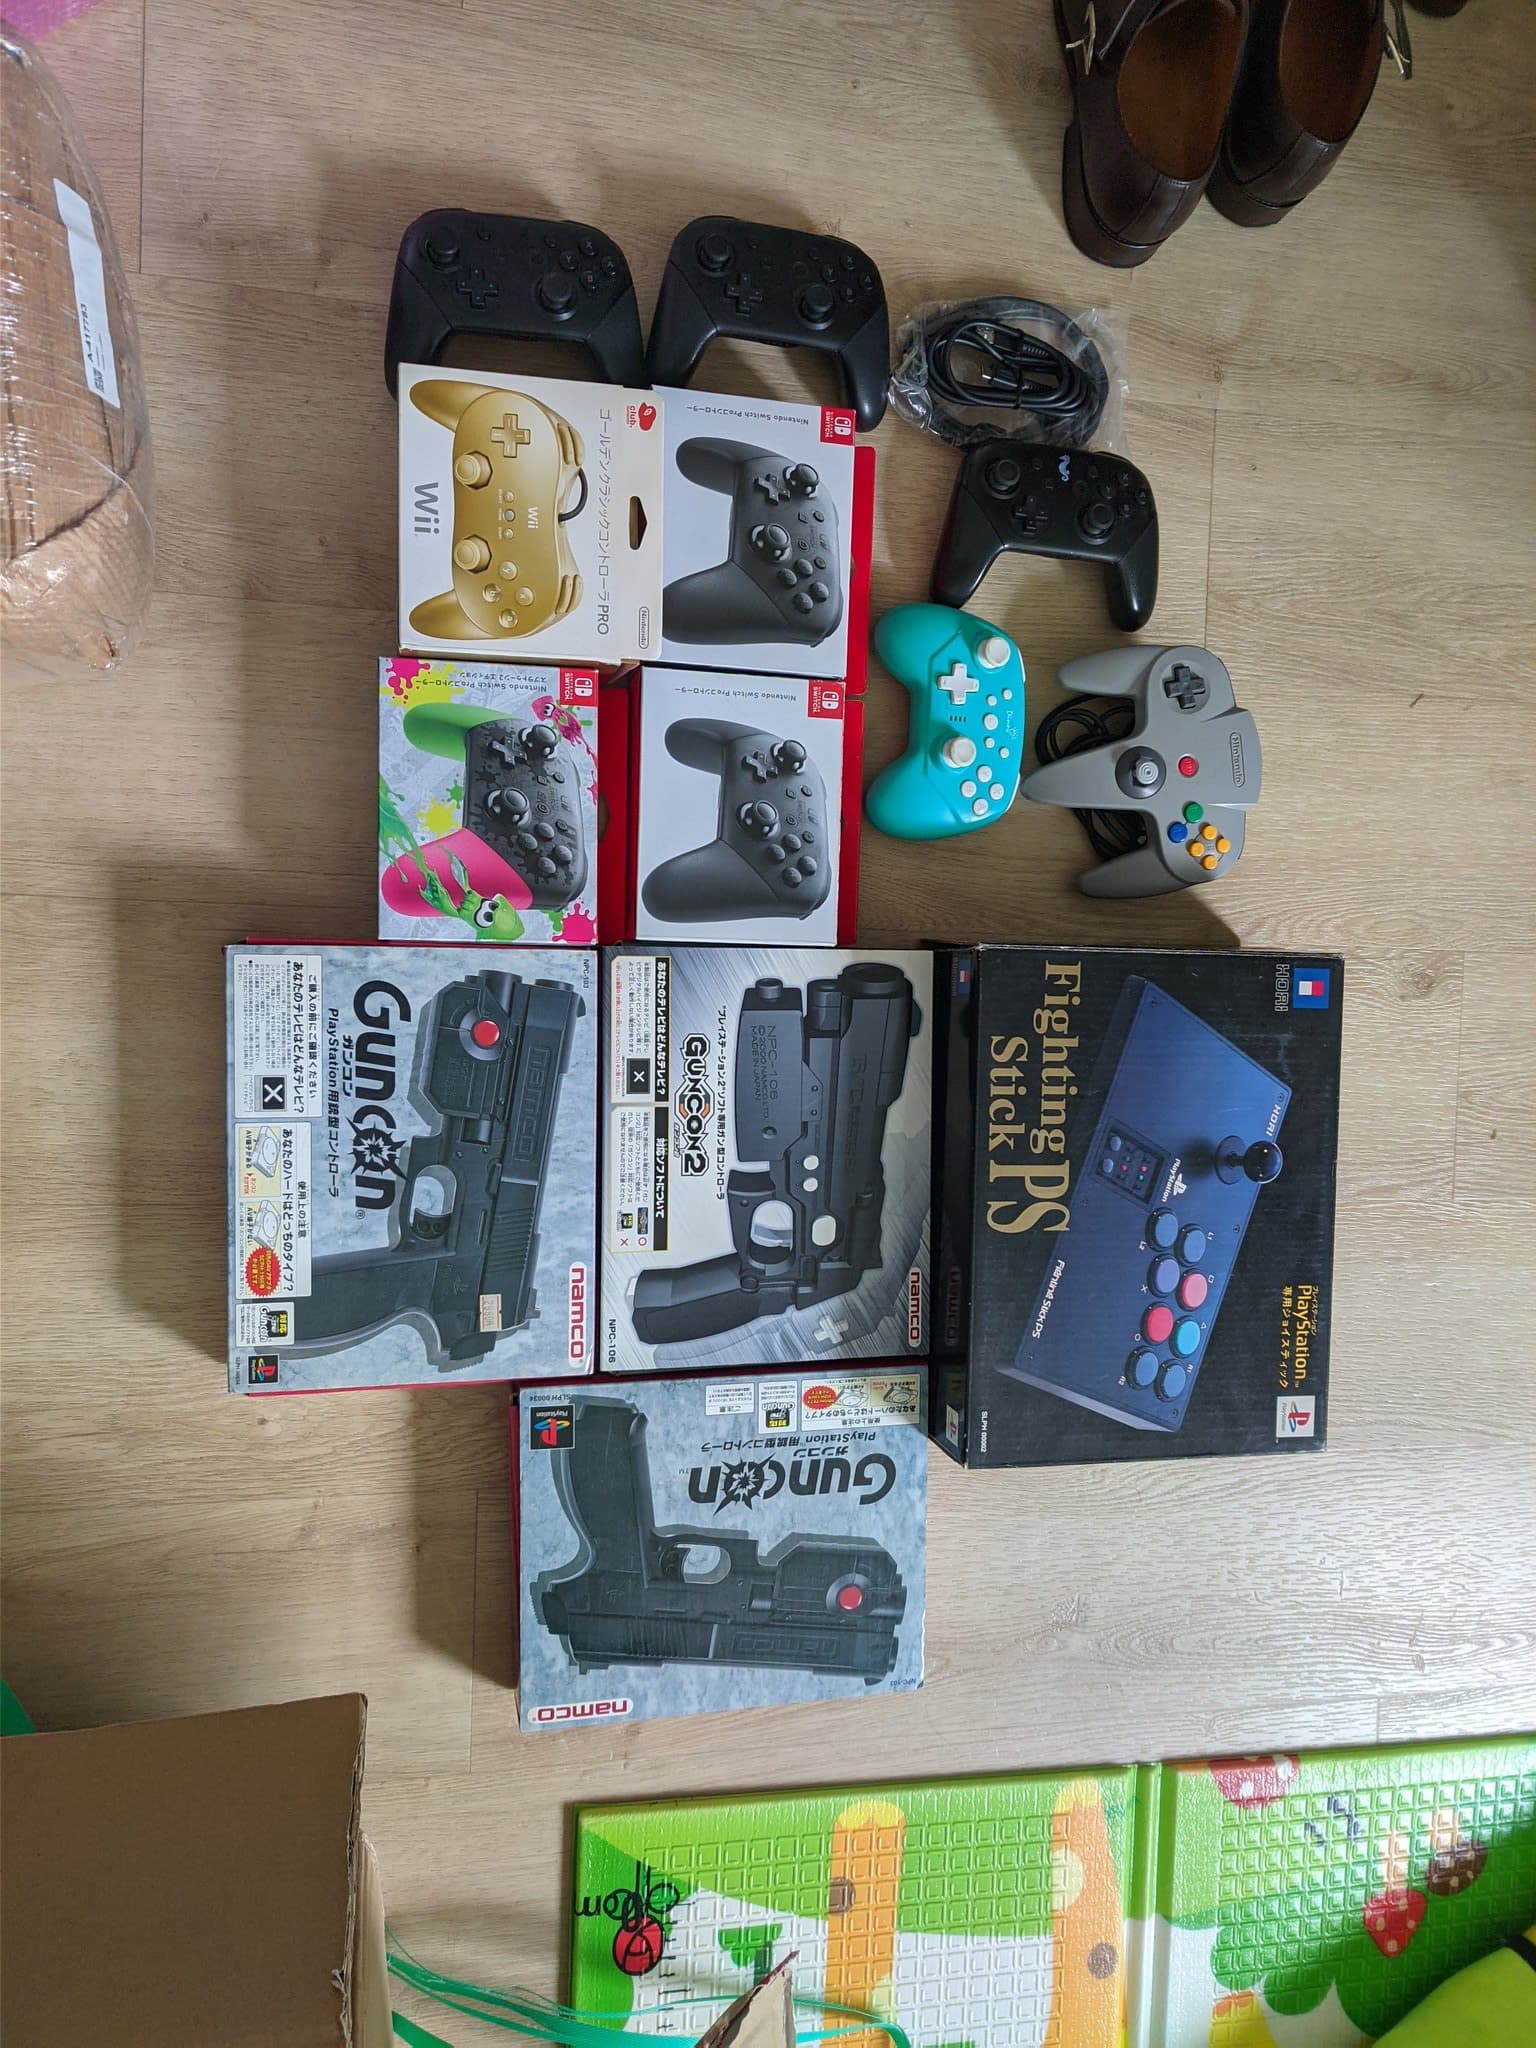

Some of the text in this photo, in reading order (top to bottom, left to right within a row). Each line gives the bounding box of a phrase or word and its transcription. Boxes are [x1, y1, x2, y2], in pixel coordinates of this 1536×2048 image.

[744, 410, 771, 422] Switch
[773, 414, 809, 426] Nintendo
[413, 481, 440, 535] Wii
[527, 506, 538, 529] Wii
[640, 608, 648, 647] Nintendo
[477, 681, 506, 690] Switch
[508, 683, 547, 693] Nintendo
[732, 689, 759, 699] Switch
[761, 692, 797, 702] Nintendo
[582, 958, 590, 989] NPC-103
[1274, 963, 1290, 1012] HORI
[308, 974, 318, 1099] ご購入の前にご確認ください
[750, 1025, 760, 1056] MADE
[341, 1034, 353, 1097] ガンコン
[759, 1064, 769, 1101] NAMCO
[767, 1025, 778, 1101] NPC-106
[752, 1068, 762, 1102] JAPAN
[985, 959, 1082, 1235] Fighting Stick PS
[1265, 1103, 1282, 1137] HORI
[656, 1137, 668, 1219] 対応ソフトについて
[1160, 1157, 1182, 1203] PlayStation
[297, 1180, 307, 1239] 使用上の注意
[570, 1267, 585, 1359] namco
[909, 1271, 921, 1341] namco
[1031, 1259, 1066, 1340] Fighting Stick PS
[607, 1318, 617, 1363] NPC-106
[1279, 1286, 1293, 1389] 専用ジョイスティック
[1291, 1284, 1312, 1380] PlayStation
[535, 1409, 569, 1418] PlayStation
[841, 1416, 881, 1425] 使用上の注意
[980, 1410, 989, 1453] SLPH 00002
[793, 1445, 849, 1459] ガンコン
[537, 1700, 628, 1723] namco
